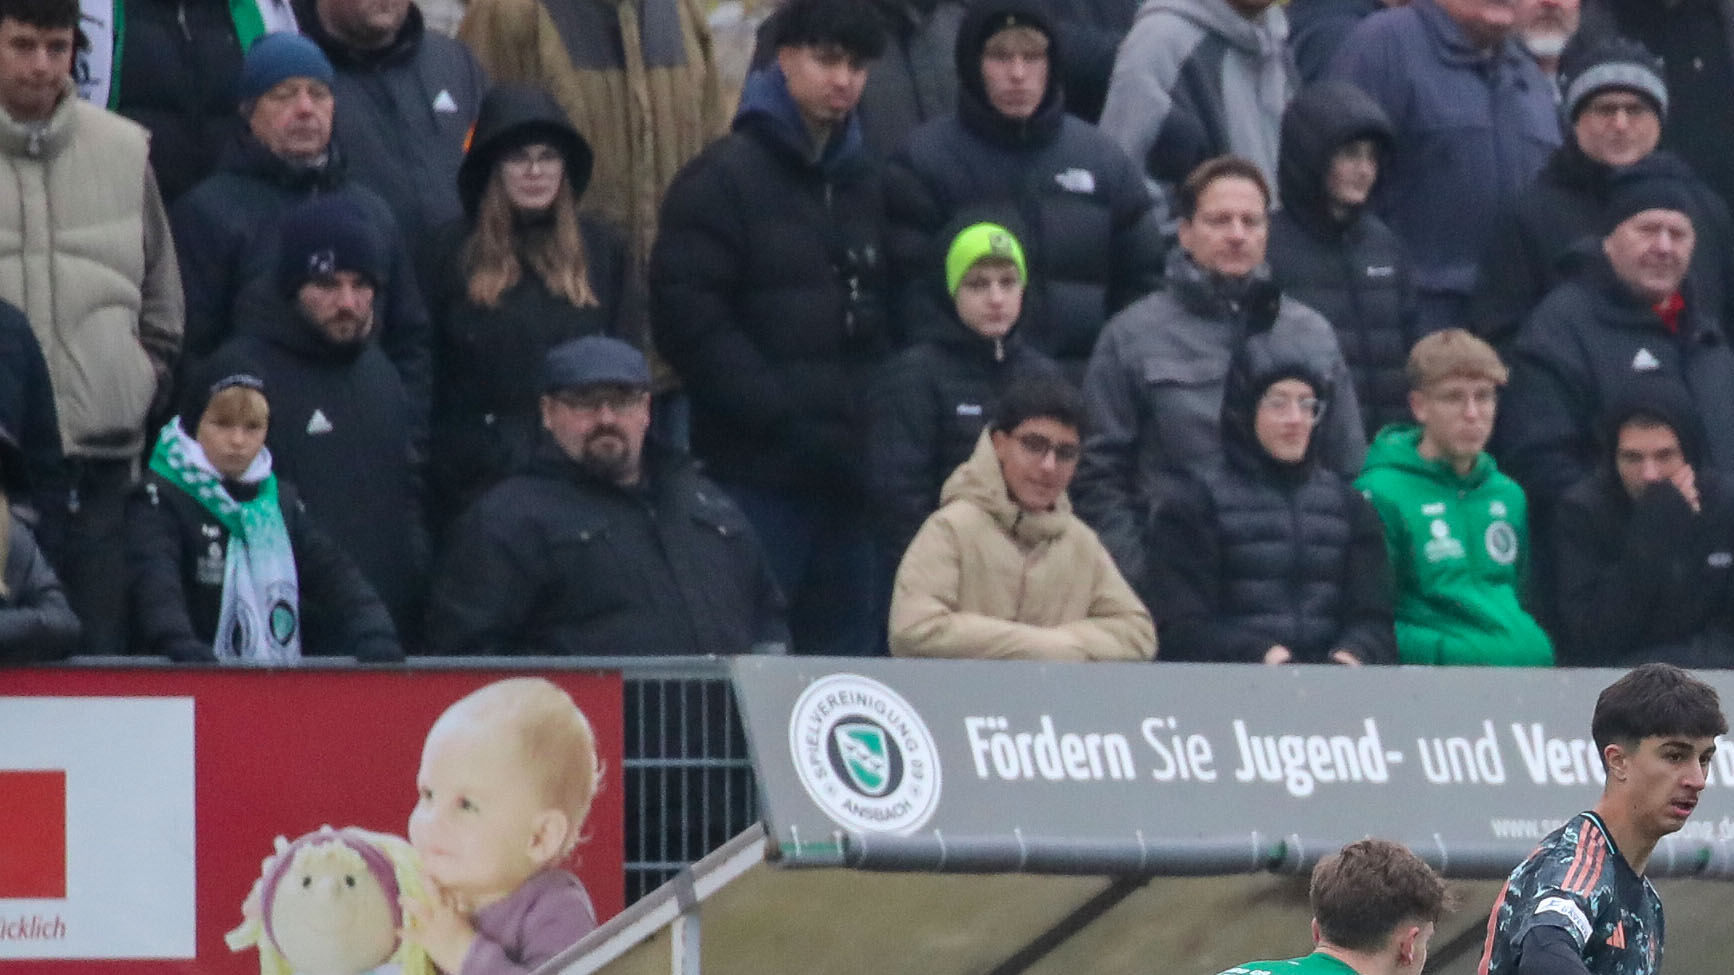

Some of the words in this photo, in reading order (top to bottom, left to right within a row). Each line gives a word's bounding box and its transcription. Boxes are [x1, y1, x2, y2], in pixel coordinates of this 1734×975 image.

[806, 690, 917, 779] SPIELVEREINIGUNG
[964, 714, 1137, 781] Fördern
[1141, 715, 1217, 782] Sie
[1232, 716, 1402, 797] Jugend-
[1417, 719, 1506, 784] und
[842, 799, 912, 821] ANSBACH
